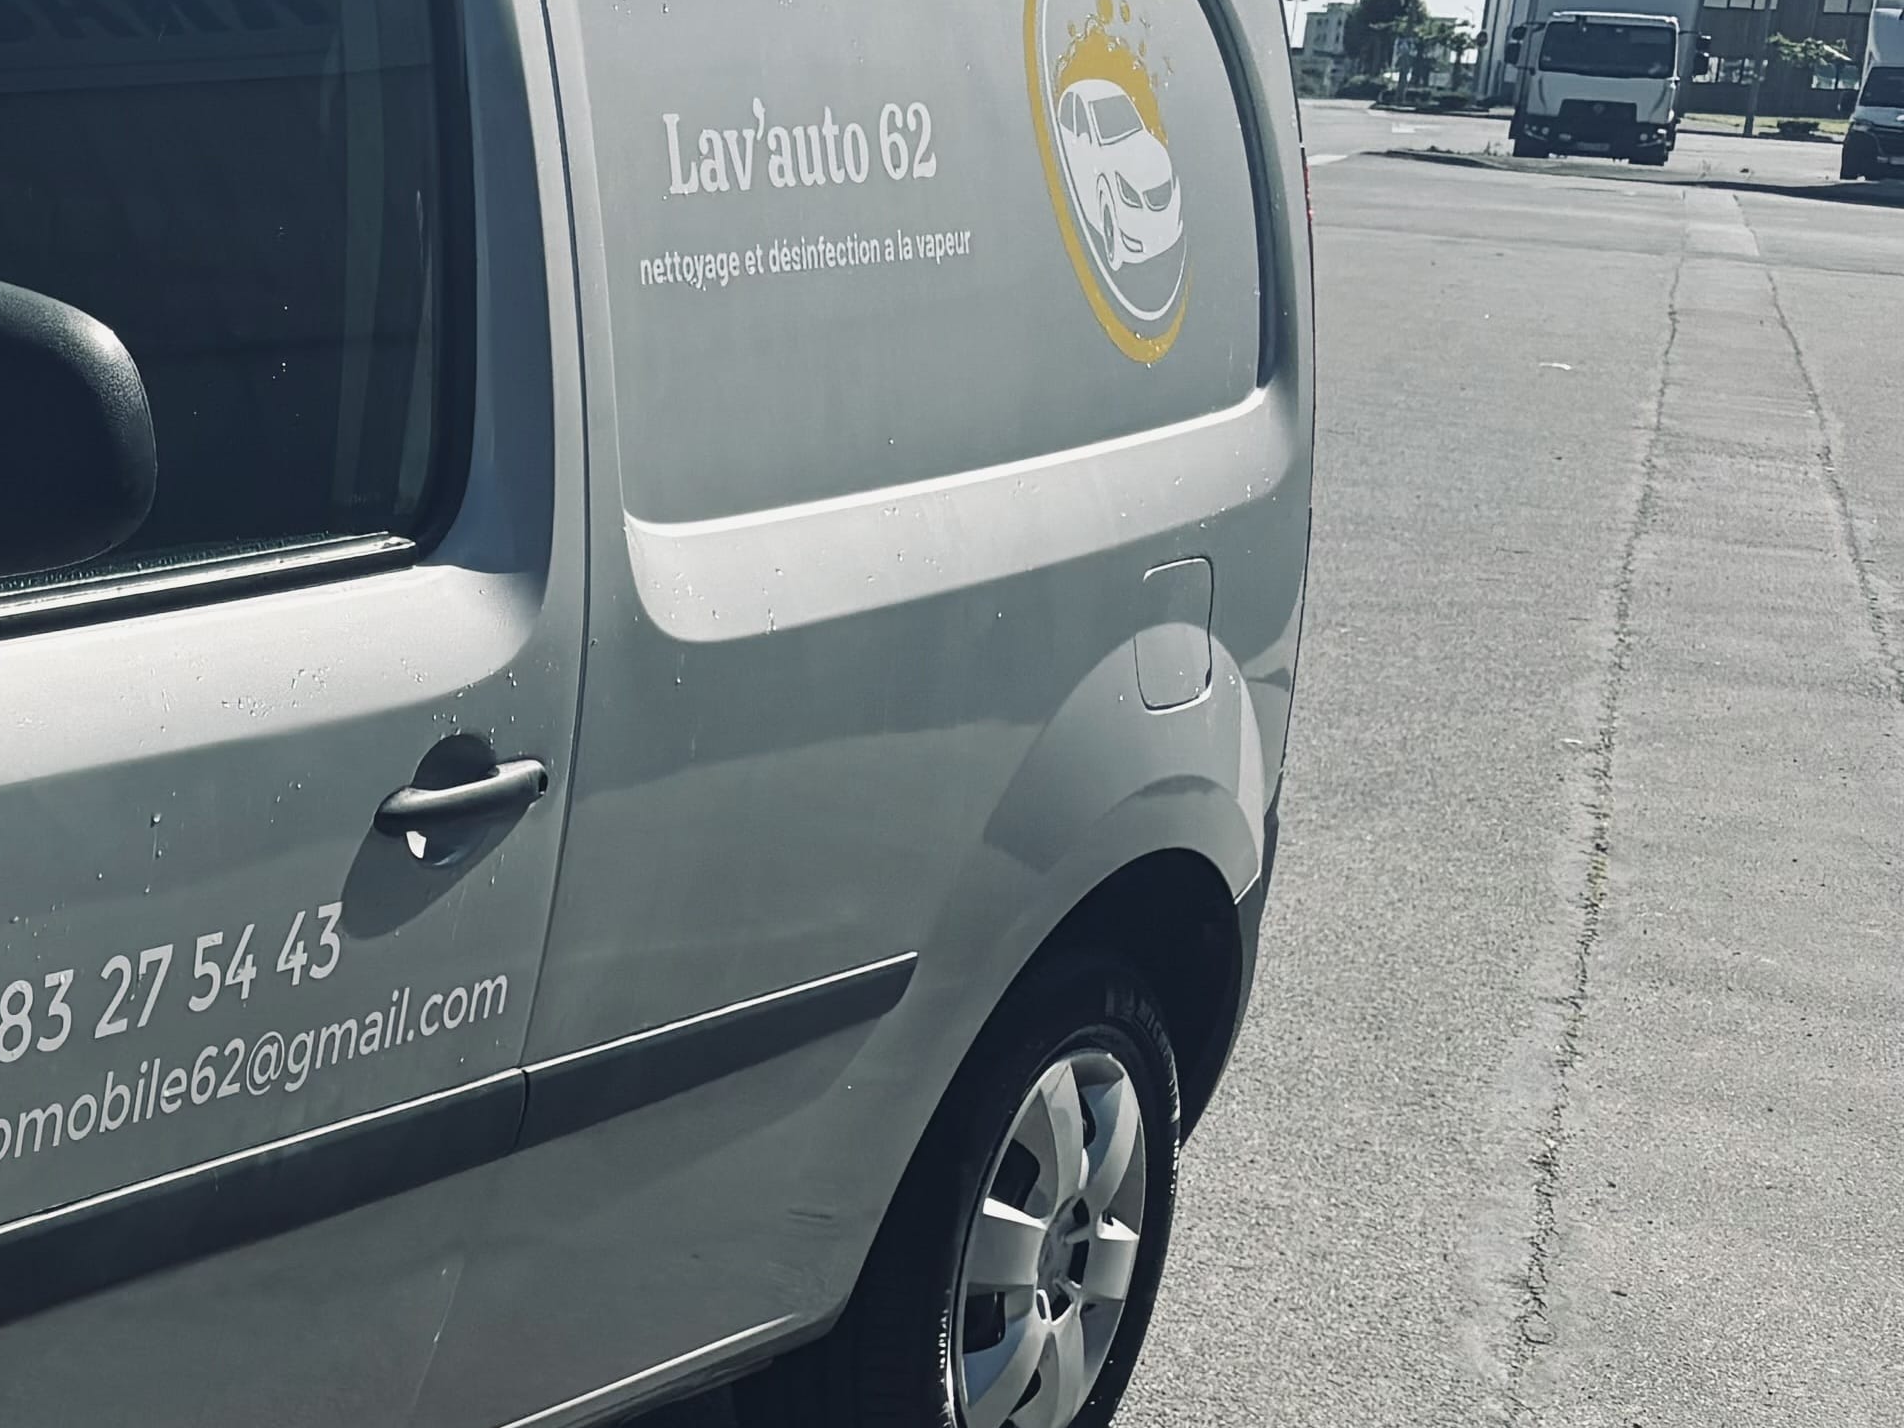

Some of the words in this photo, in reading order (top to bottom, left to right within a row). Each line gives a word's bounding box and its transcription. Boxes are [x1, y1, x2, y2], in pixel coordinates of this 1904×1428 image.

[662, 97, 869, 194] Lav'auto
[879, 101, 937, 180] 62
[640, 251, 740, 289] nettoyage
[744, 243, 764, 275] et
[768, 232, 880, 272] désinfection
[884, 237, 895, 262] a
[897, 229, 913, 261] la
[916, 230, 970, 264] vapeur
[94, 944, 174, 1040] 27
[188, 923, 257, 1012] 54
[276, 902, 343, 986] 43
